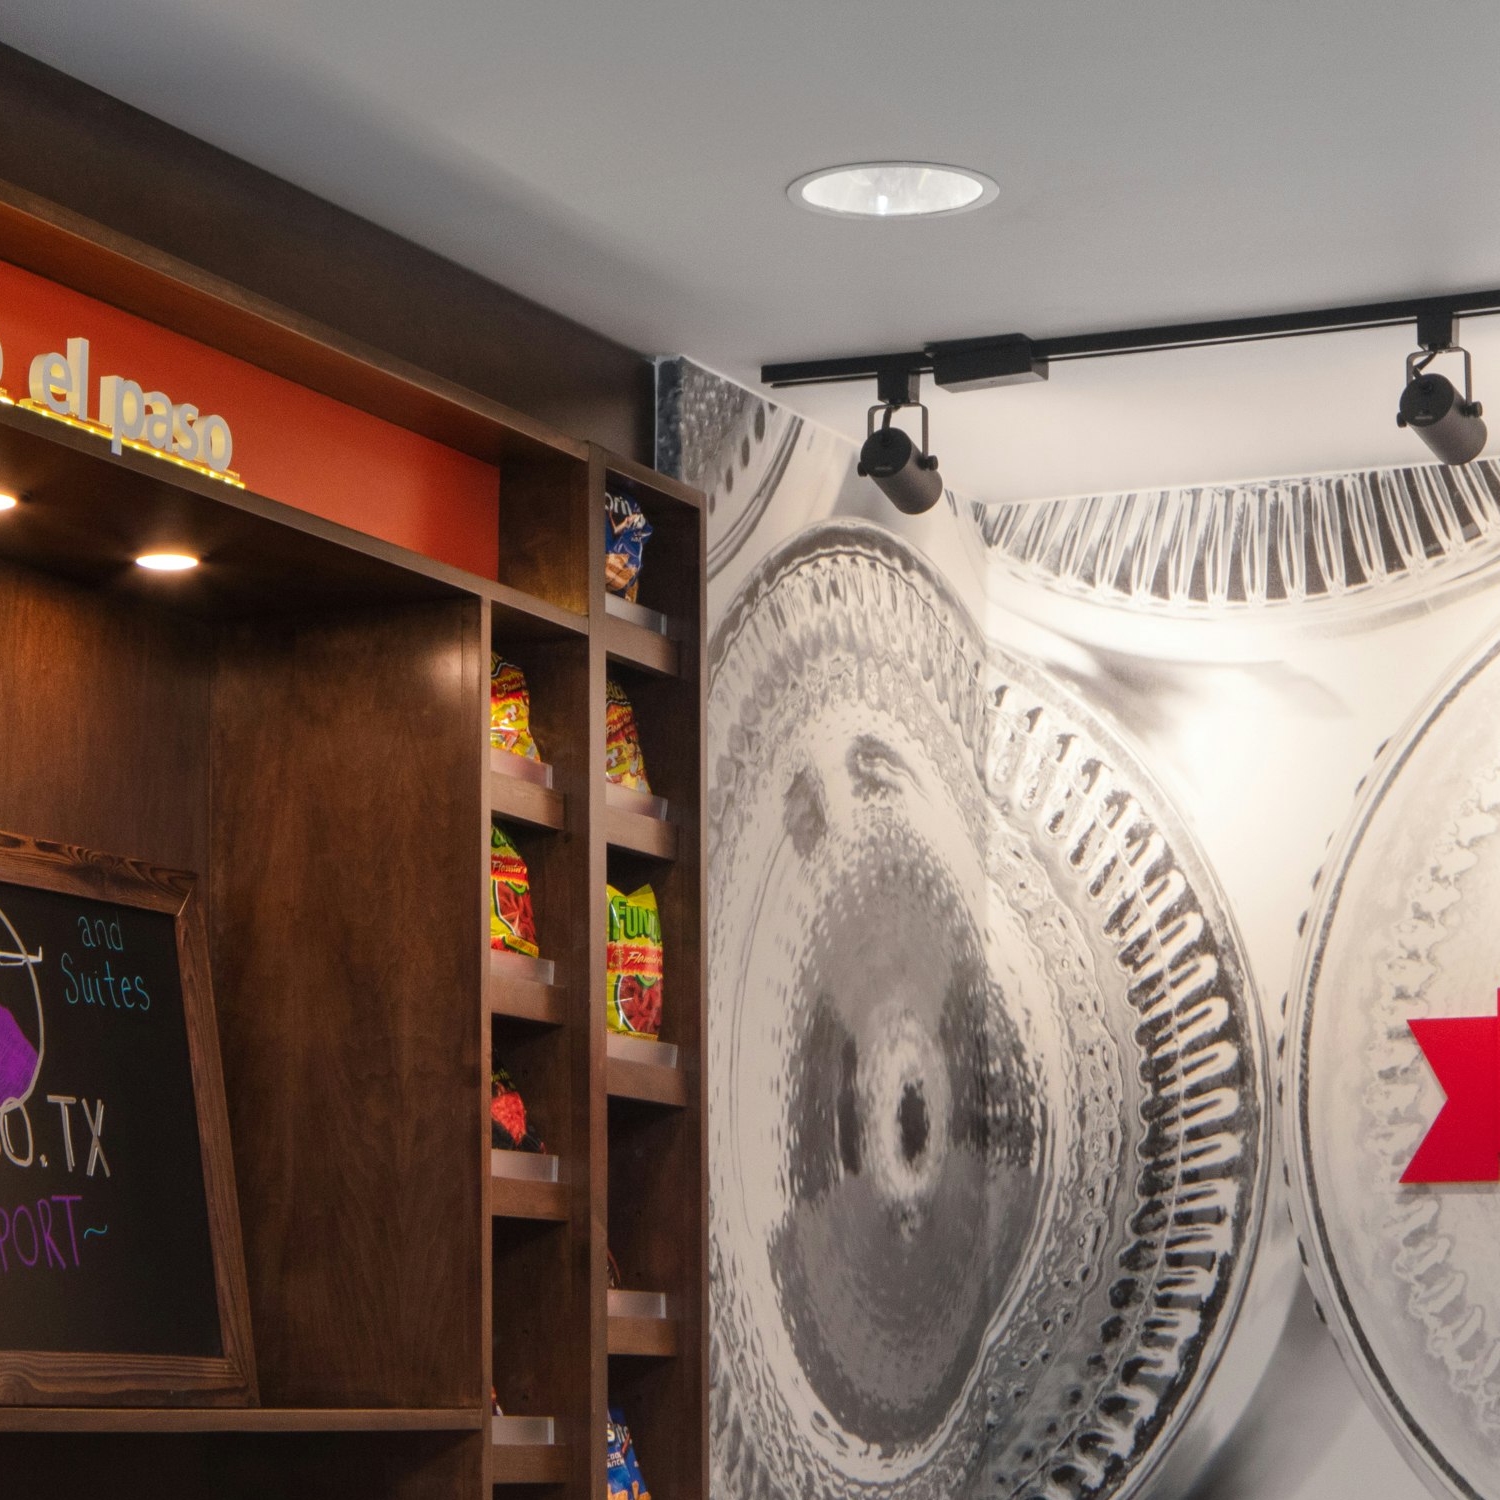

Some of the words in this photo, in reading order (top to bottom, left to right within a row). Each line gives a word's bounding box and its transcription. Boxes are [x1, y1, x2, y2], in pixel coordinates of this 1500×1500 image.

[29, 337, 89, 420] el
[100, 375, 233, 472] paso
[76, 913, 124, 953] and
[60, 952, 151, 1012] Suites
[47, 1094, 111, 1178] TX
